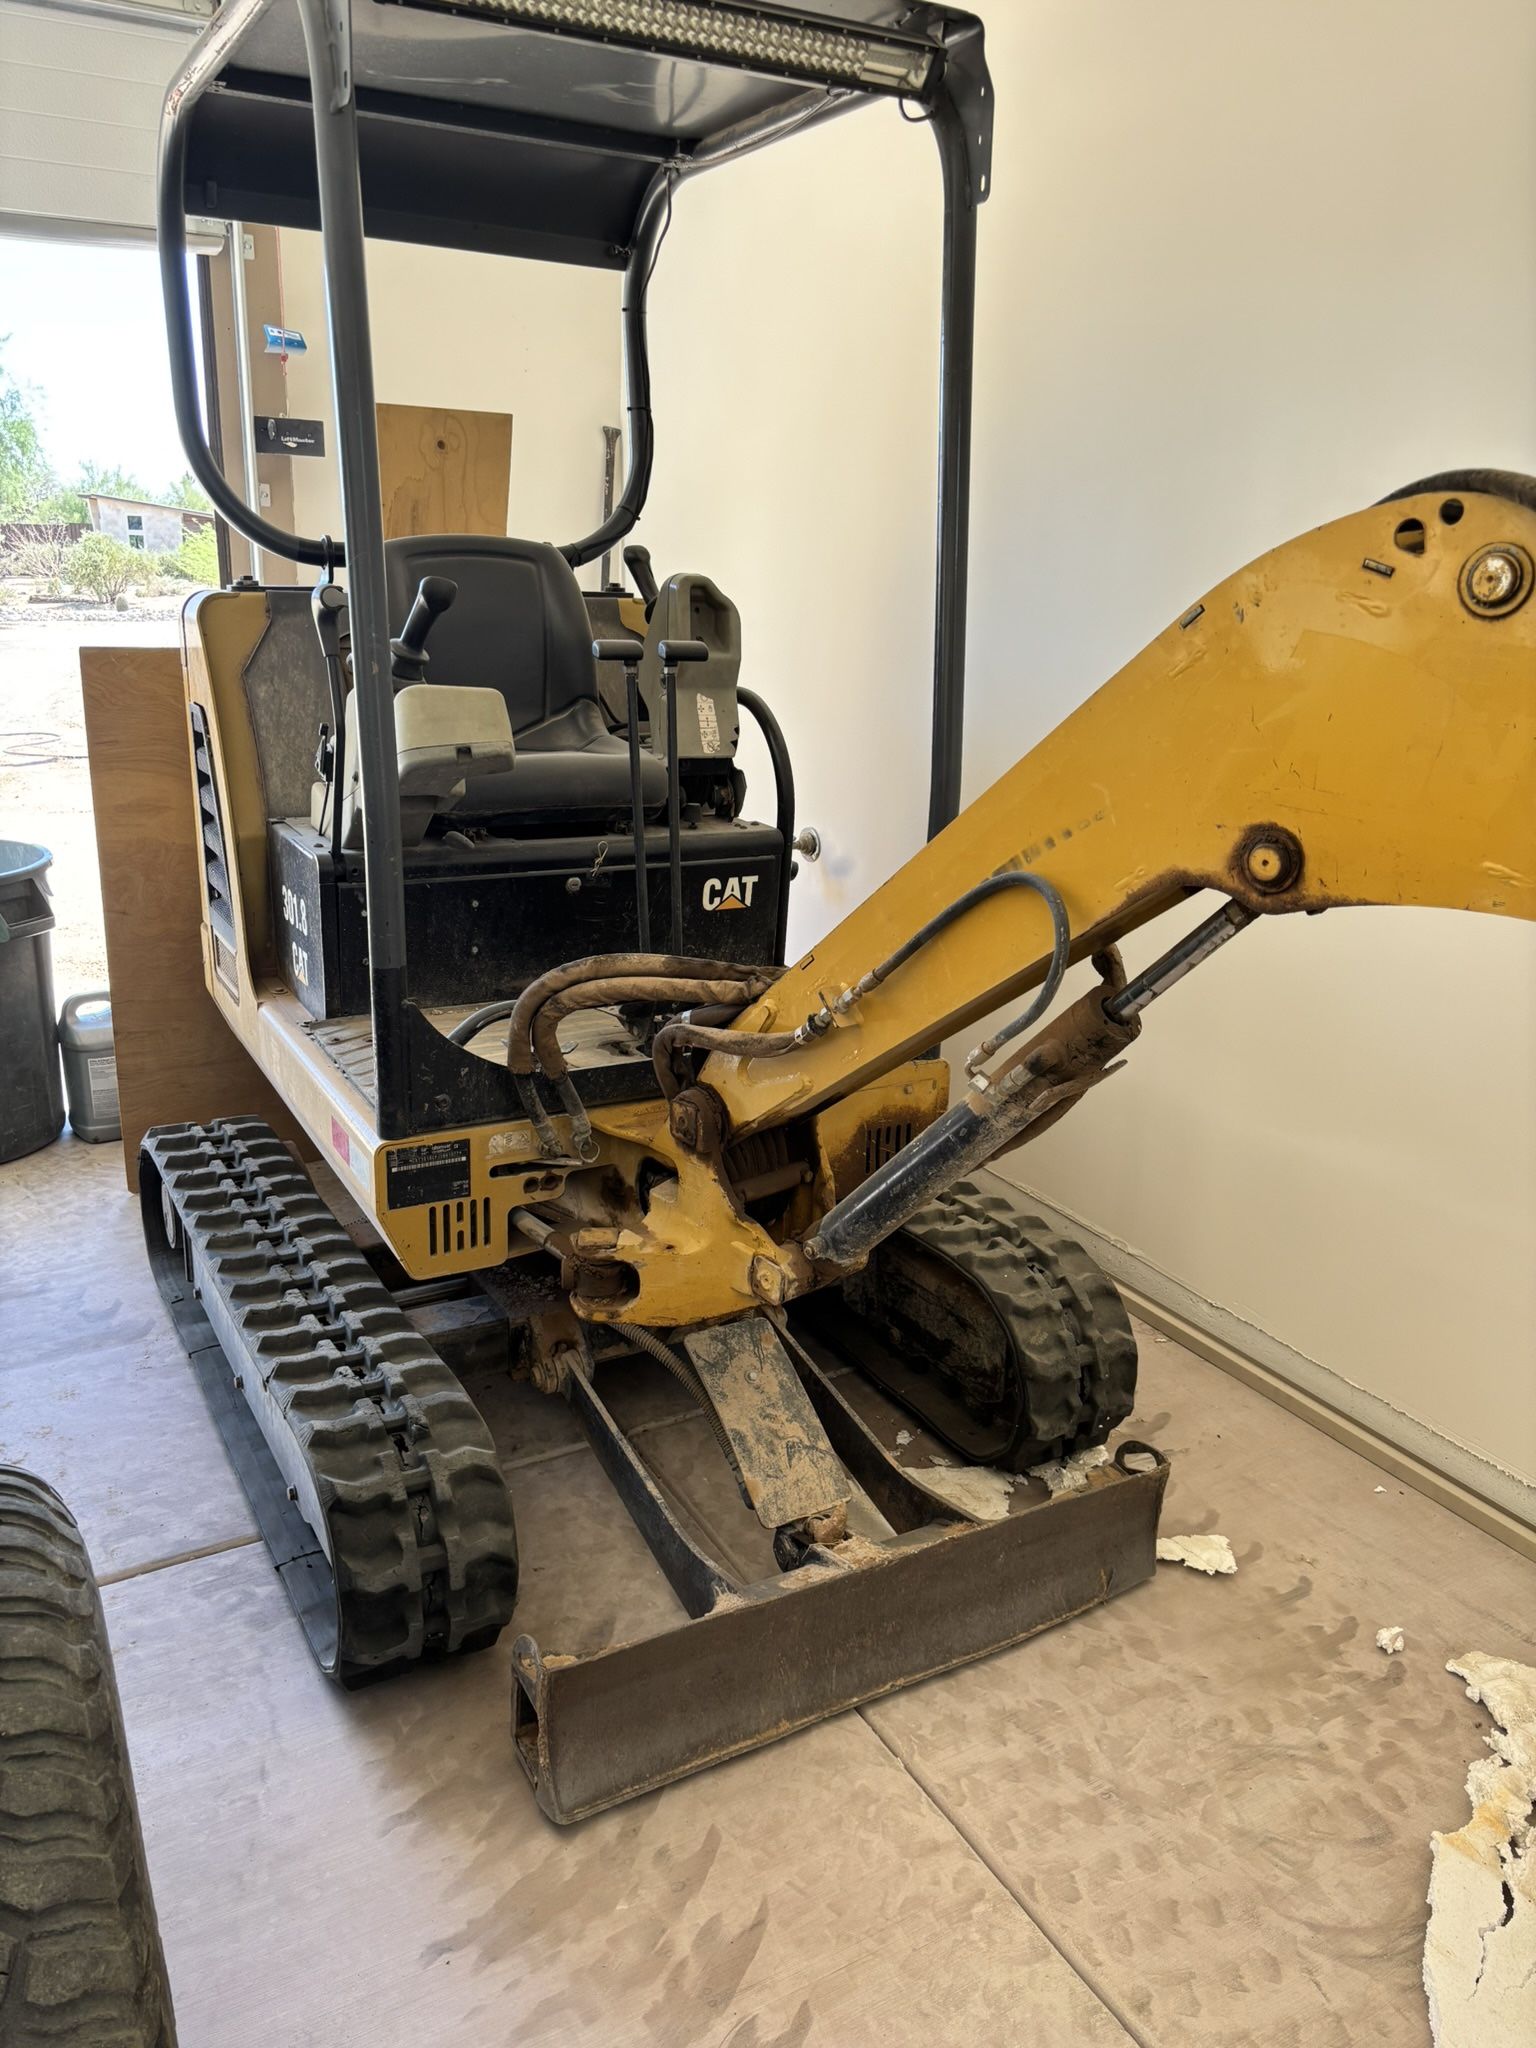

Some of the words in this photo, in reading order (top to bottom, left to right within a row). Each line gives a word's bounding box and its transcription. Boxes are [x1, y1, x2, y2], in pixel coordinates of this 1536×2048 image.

[282, 885, 308, 936] 301.8
[702, 875, 759, 911] CAT
[292, 941, 309, 986] CAT
